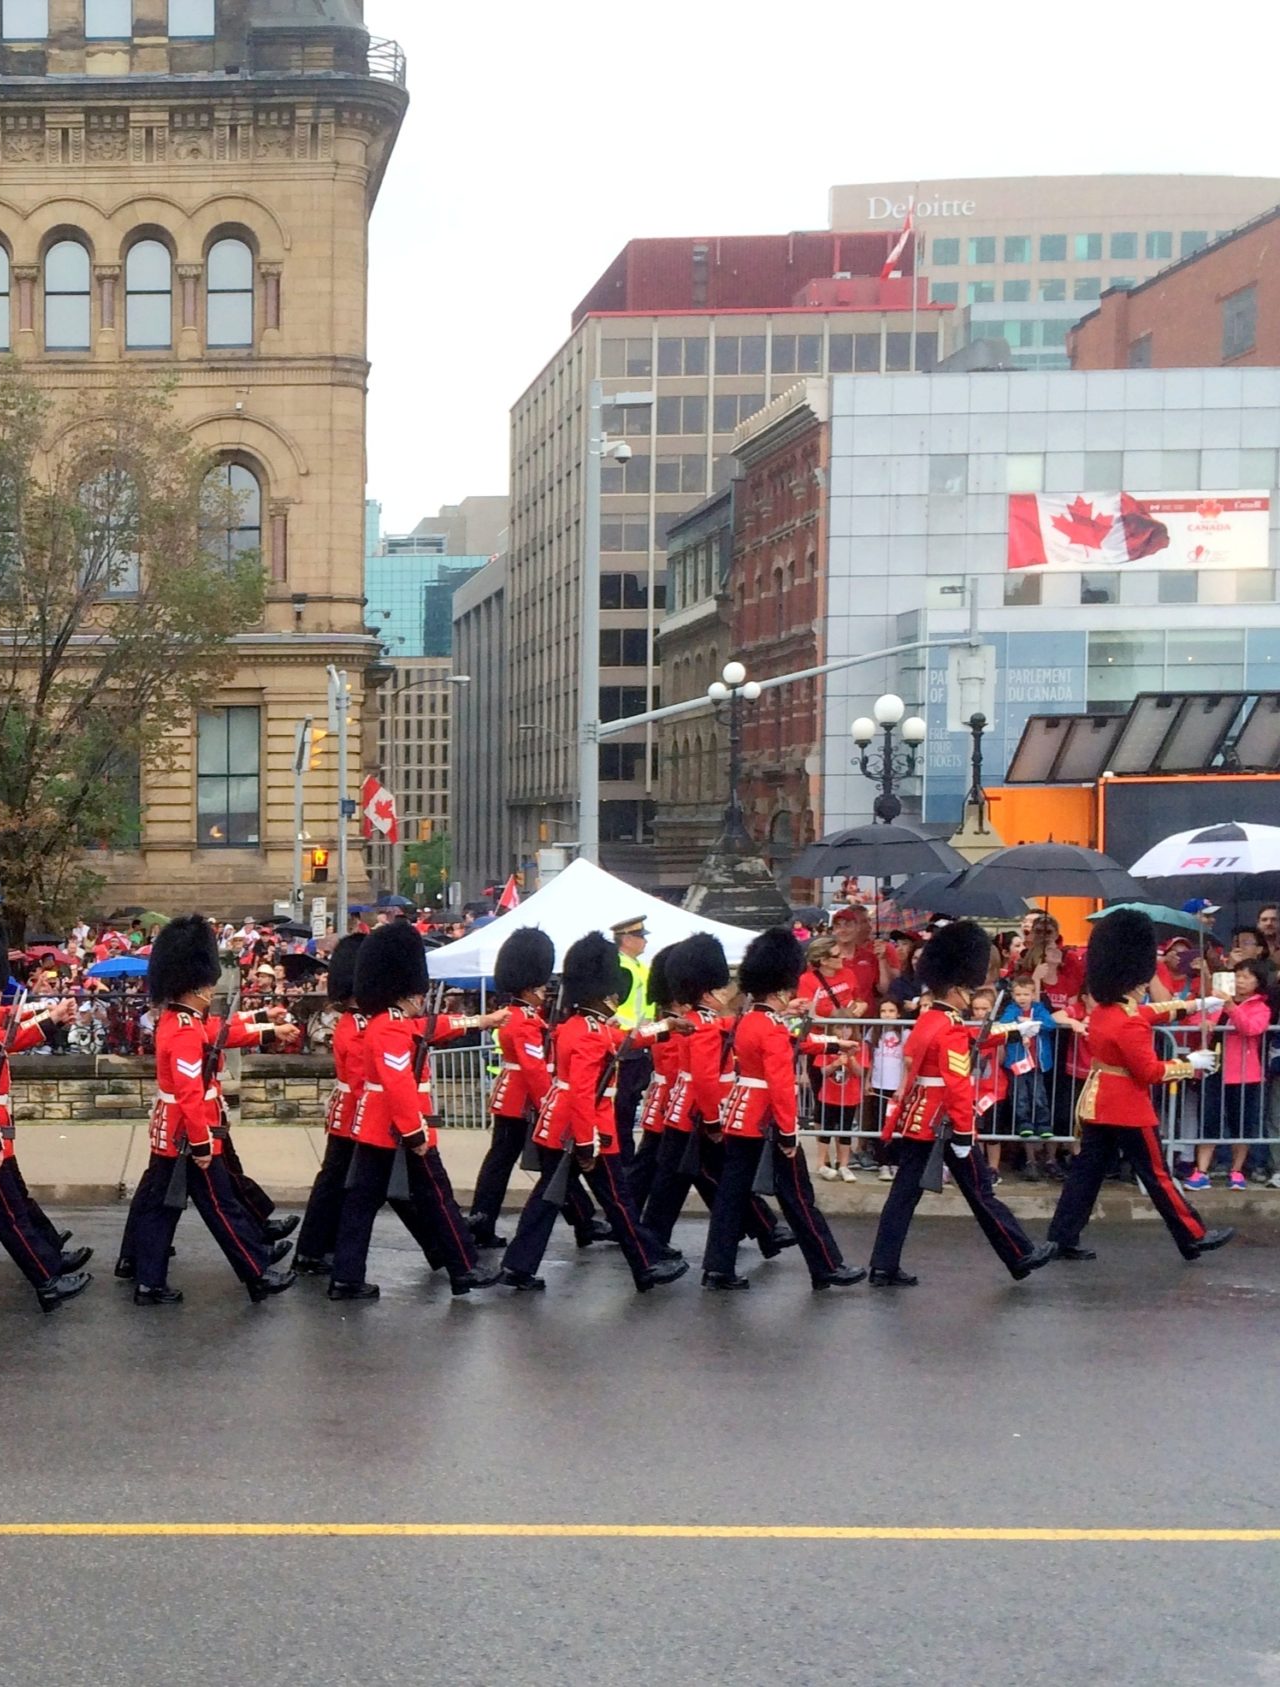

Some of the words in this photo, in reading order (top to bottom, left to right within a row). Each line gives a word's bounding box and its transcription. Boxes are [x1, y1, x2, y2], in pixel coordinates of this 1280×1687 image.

[867, 193, 976, 220] Deloitte
[1187, 523, 1231, 532] CANADA
[1008, 668, 1072, 684] PARLEMENT
[930, 688, 945, 703] OF
[1008, 687, 1025, 702] DU
[1027, 686, 1073, 702] CANADA
[929, 741, 952, 753] TOUR
[929, 754, 961, 767] TICKETS
[1180, 856, 1241, 868] R11
